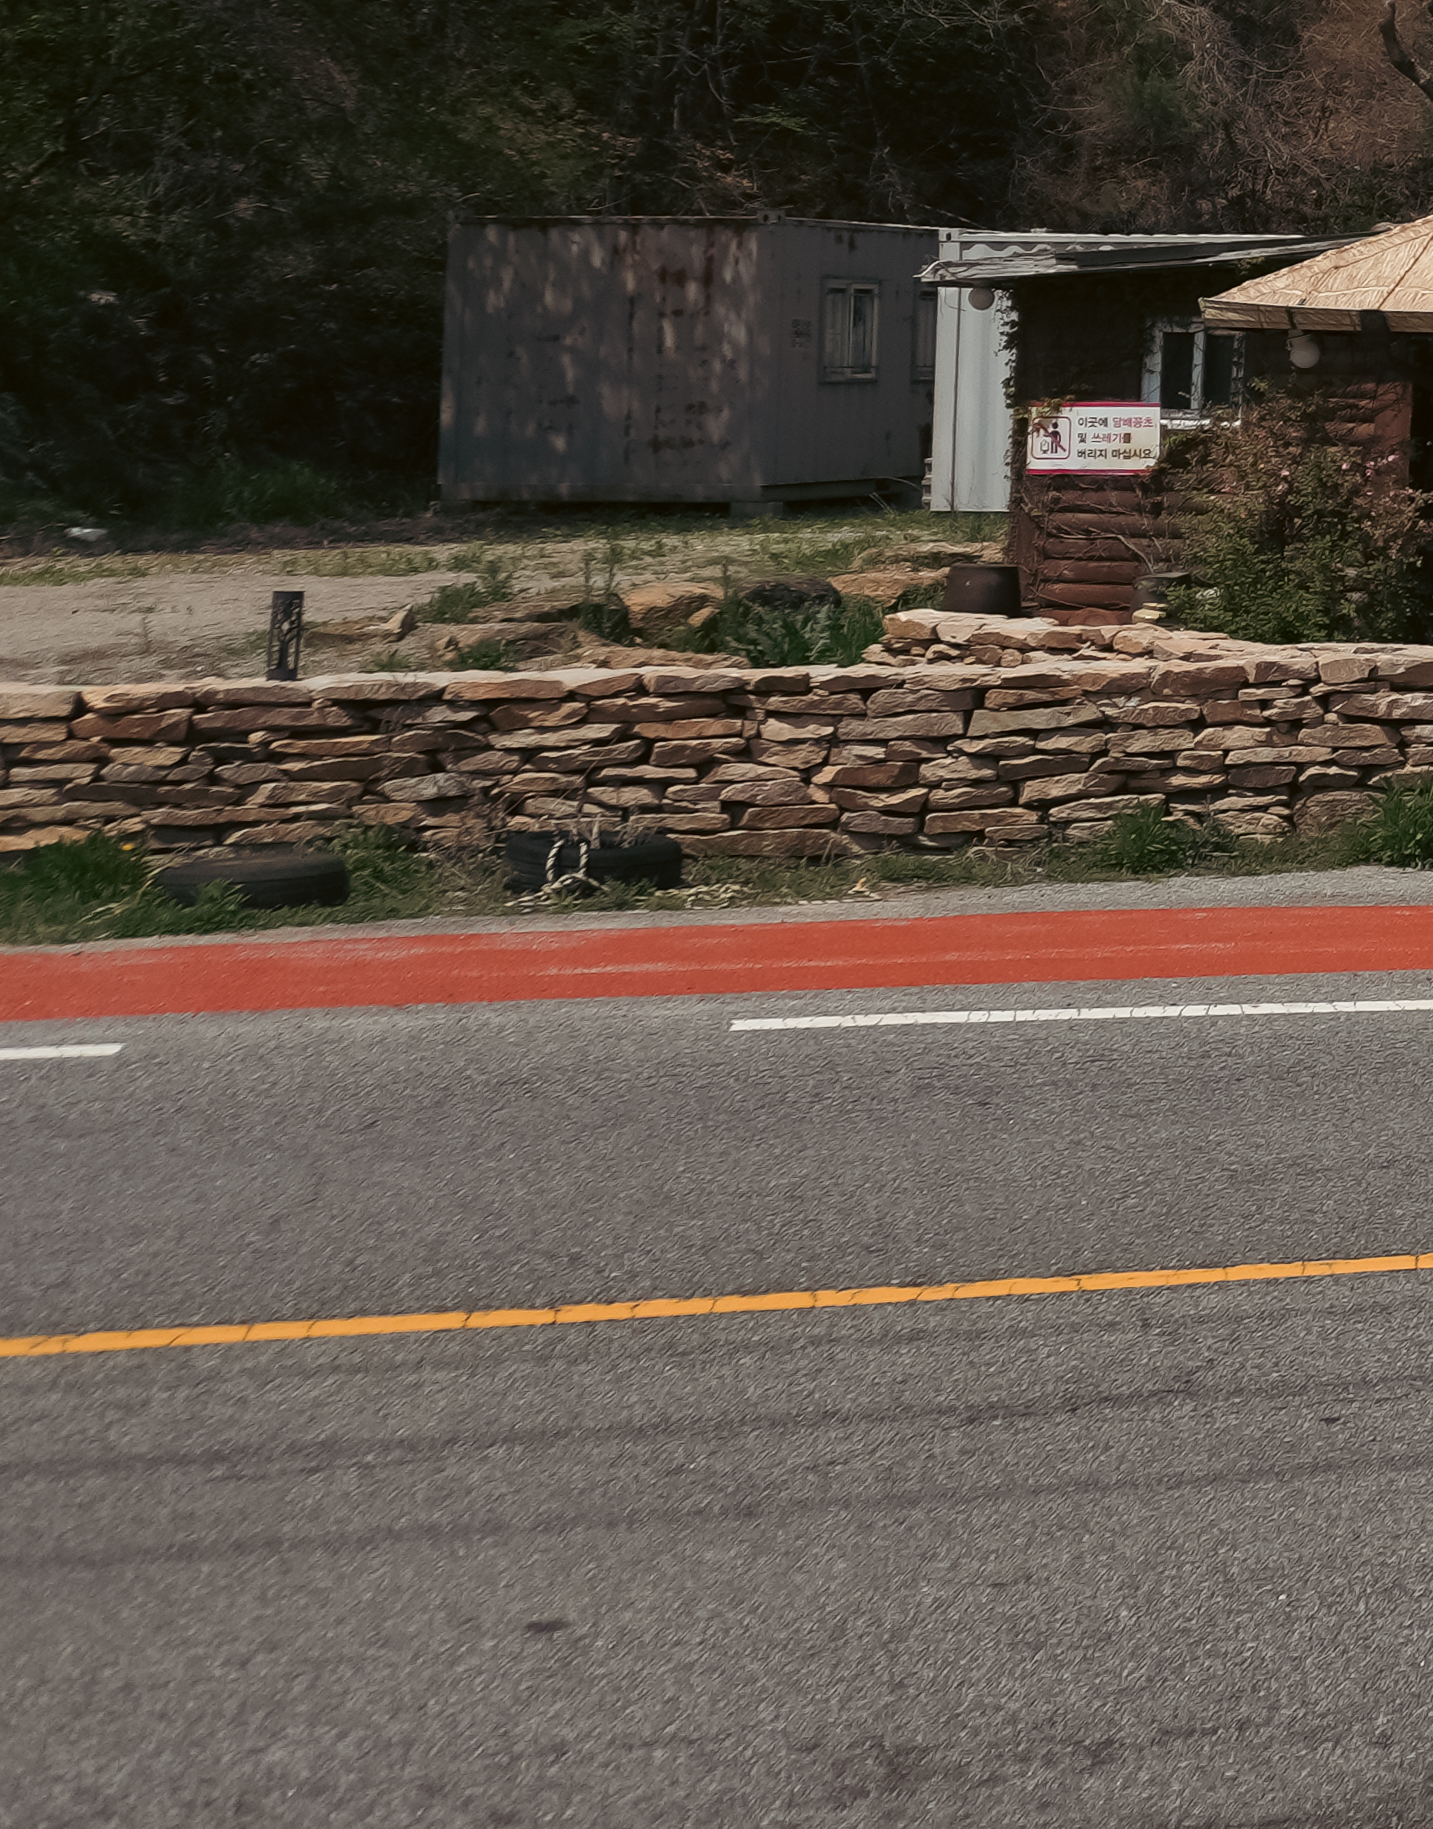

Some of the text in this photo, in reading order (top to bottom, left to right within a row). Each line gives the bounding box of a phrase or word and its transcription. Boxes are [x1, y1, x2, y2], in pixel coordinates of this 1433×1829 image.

[1077, 416, 1154, 428] 이곳에 담배꽁초
[1077, 433, 1131, 444] 및 쓰레기를
[1077, 448, 1107, 459] 버리지
